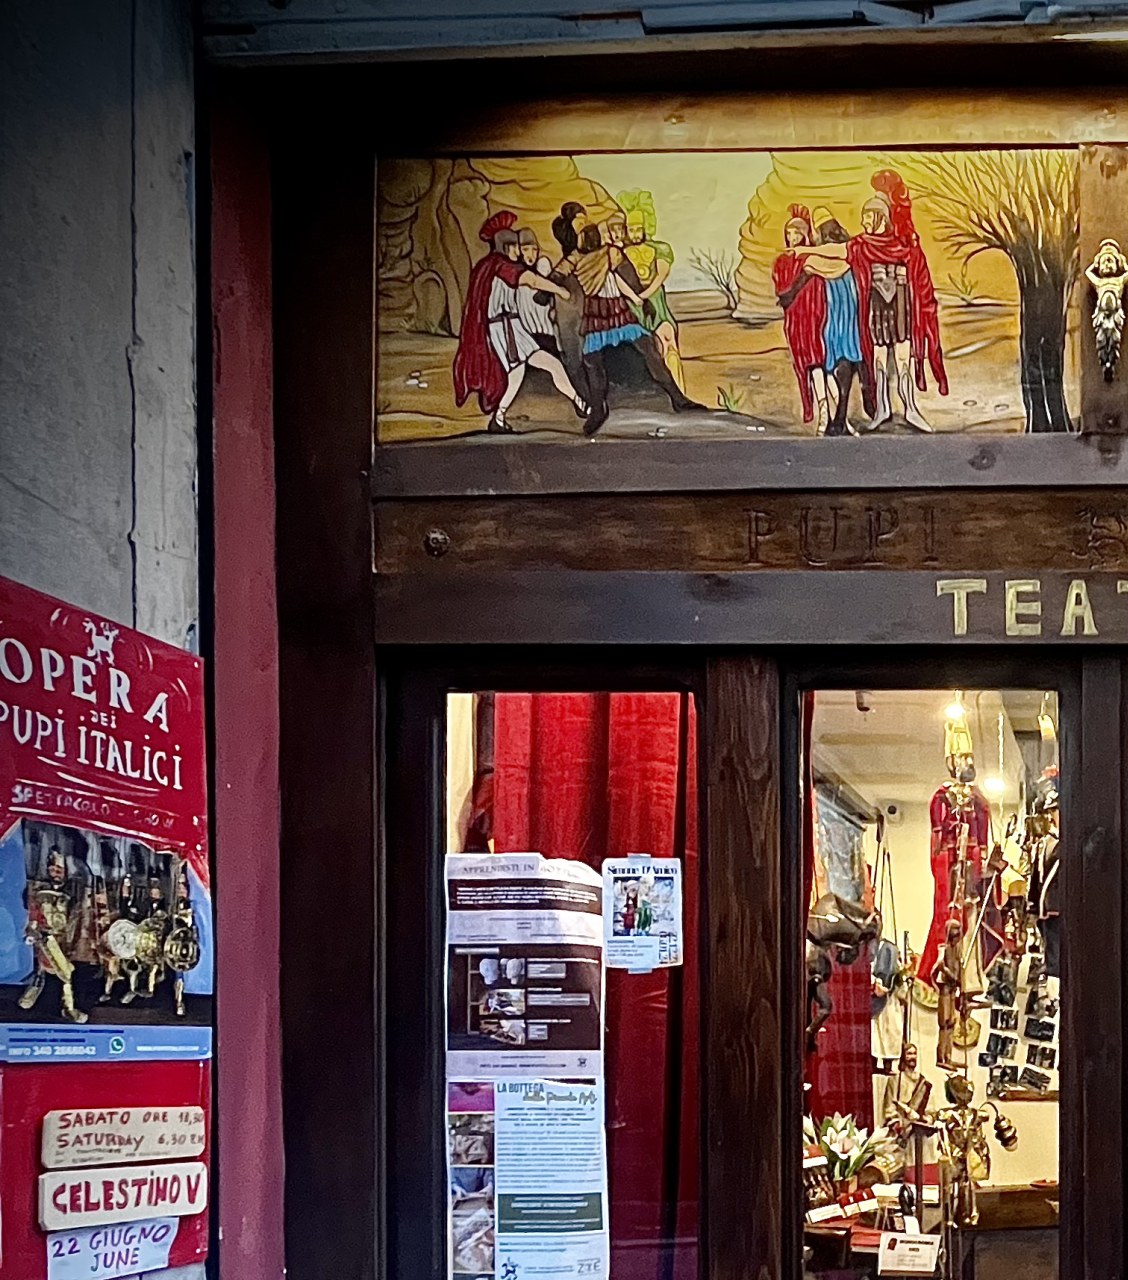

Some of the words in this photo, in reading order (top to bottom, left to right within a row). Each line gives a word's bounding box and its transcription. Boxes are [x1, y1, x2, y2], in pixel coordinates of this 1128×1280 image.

[743, 506, 936, 567] PUPI
[0, 637, 170, 733] OPERA
[77, 715, 183, 790] ITALICI
[58, 1110, 131, 1129] SABATO
[142, 1112, 168, 1124] ORE
[56, 1132, 145, 1151] SATURDAY
[52, 1169, 181, 1214] CELESTINO
[186, 1173, 201, 1204] V
[52, 1237, 81, 1258] 22
[89, 1224, 171, 1250] GIUGNO
[90, 1247, 140, 1273] JUNE
